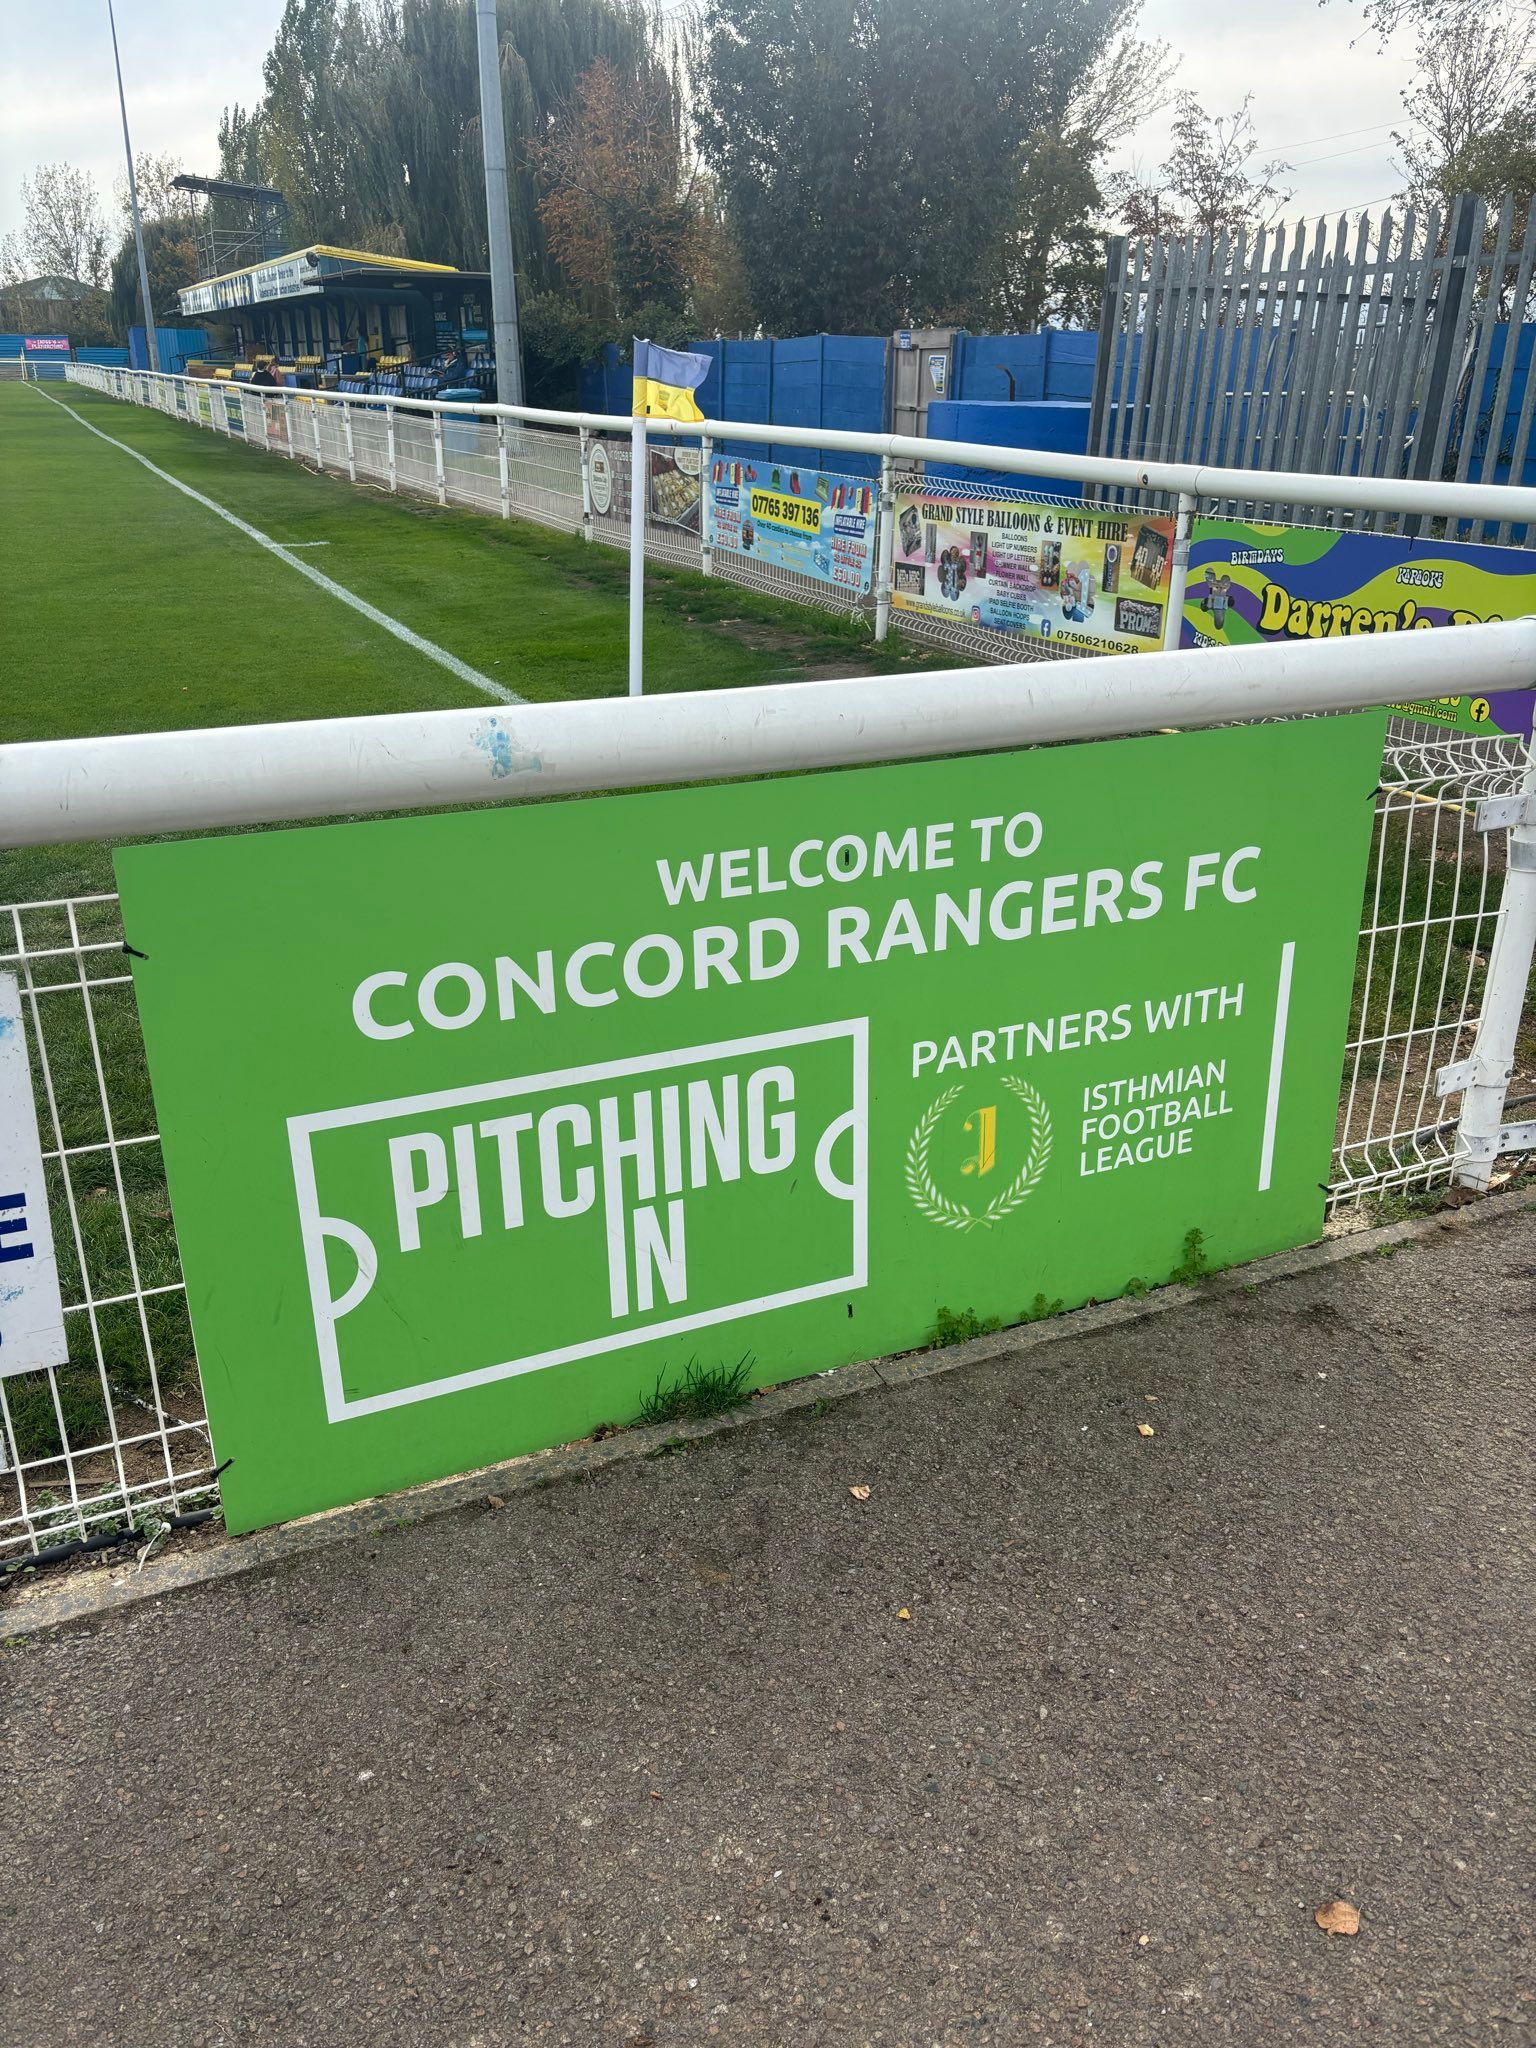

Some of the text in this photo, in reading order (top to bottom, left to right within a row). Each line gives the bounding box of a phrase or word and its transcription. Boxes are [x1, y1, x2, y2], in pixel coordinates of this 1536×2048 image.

[752, 494, 819, 528] 07765 397 136
[835, 515, 866, 530] INFLATABLE HIRE
[922, 503, 1128, 542] GRAND STYLE BALLOONS & EVENT HIRE
[831, 536, 846, 552] HIRE
[847, 540, 866, 558] FROM
[992, 542, 1005, 550] LIGHT
[1014, 544, 1037, 553] NUMBERS
[1002, 533, 1028, 542] BALLOONS
[992, 551, 1006, 559] LIGHT
[1014, 554, 1035, 563] LETTERS
[1231, 549, 1284, 566] BIRTHDAYS
[988, 579, 1036, 592] CURTAIN BACKDROP
[996, 571, 1029, 582] FLOWER WALL
[1398, 567, 1444, 588] KARAOKE
[990, 607, 1030, 621] BALLOON HOOPS
[1000, 599, 1015, 608] SELFIE
[1017, 602, 1034, 612] BOOTH
[994, 618, 1026, 630] SEAT COVERS
[1056, 630, 1139, 655] 07506210628
[655, 811, 1044, 907] WELCOME TO
[351, 845, 1262, 1042] CONCORD RANGERS FC
[911, 982, 1245, 1079] PARTNERS WITH
[1083, 1058, 1227, 1113] ISTHMIAN
[1080, 1089, 1234, 1146] FOOTBALL
[388, 1065, 797, 1255] PITCHING
[1079, 1127, 1194, 1178] LEAGUE
[603, 1199, 689, 1319] IN
